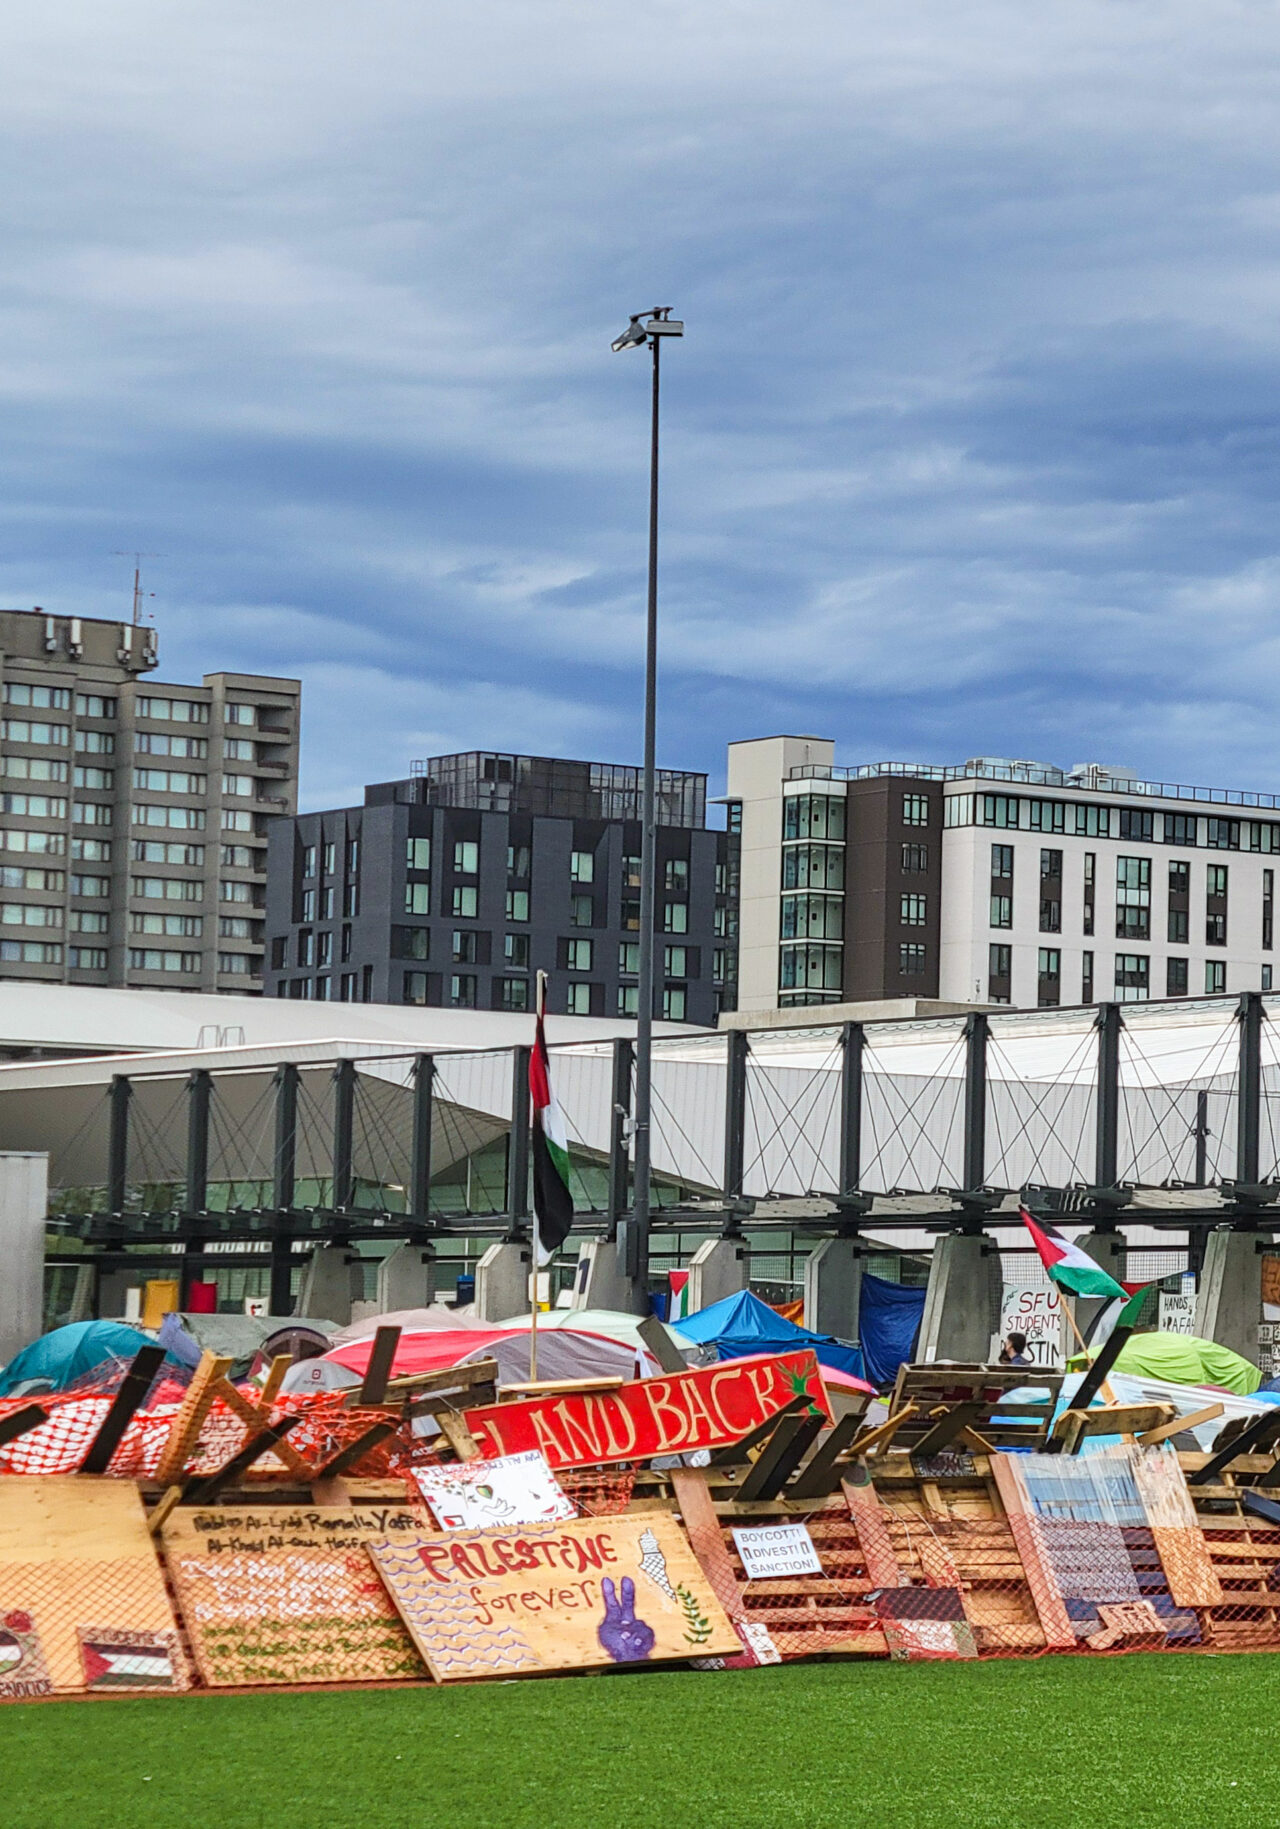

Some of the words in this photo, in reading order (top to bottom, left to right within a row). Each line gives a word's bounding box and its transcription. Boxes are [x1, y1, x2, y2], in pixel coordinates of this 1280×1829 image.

[578, 1257, 591, 1295] 1
[1018, 1291, 1060, 1314] SFU
[1164, 1296, 1188, 1311] HANDS
[1026, 1328, 1044, 1339] FOR
[641, 1366, 783, 1452] BACK
[740, 1528, 801, 1543] BOYCOTT!
[753, 1545, 799, 1558] DIVEST!
[751, 1559, 816, 1574] SANCTION!
[0, 1678, 53, 1698] ENOCIDE
